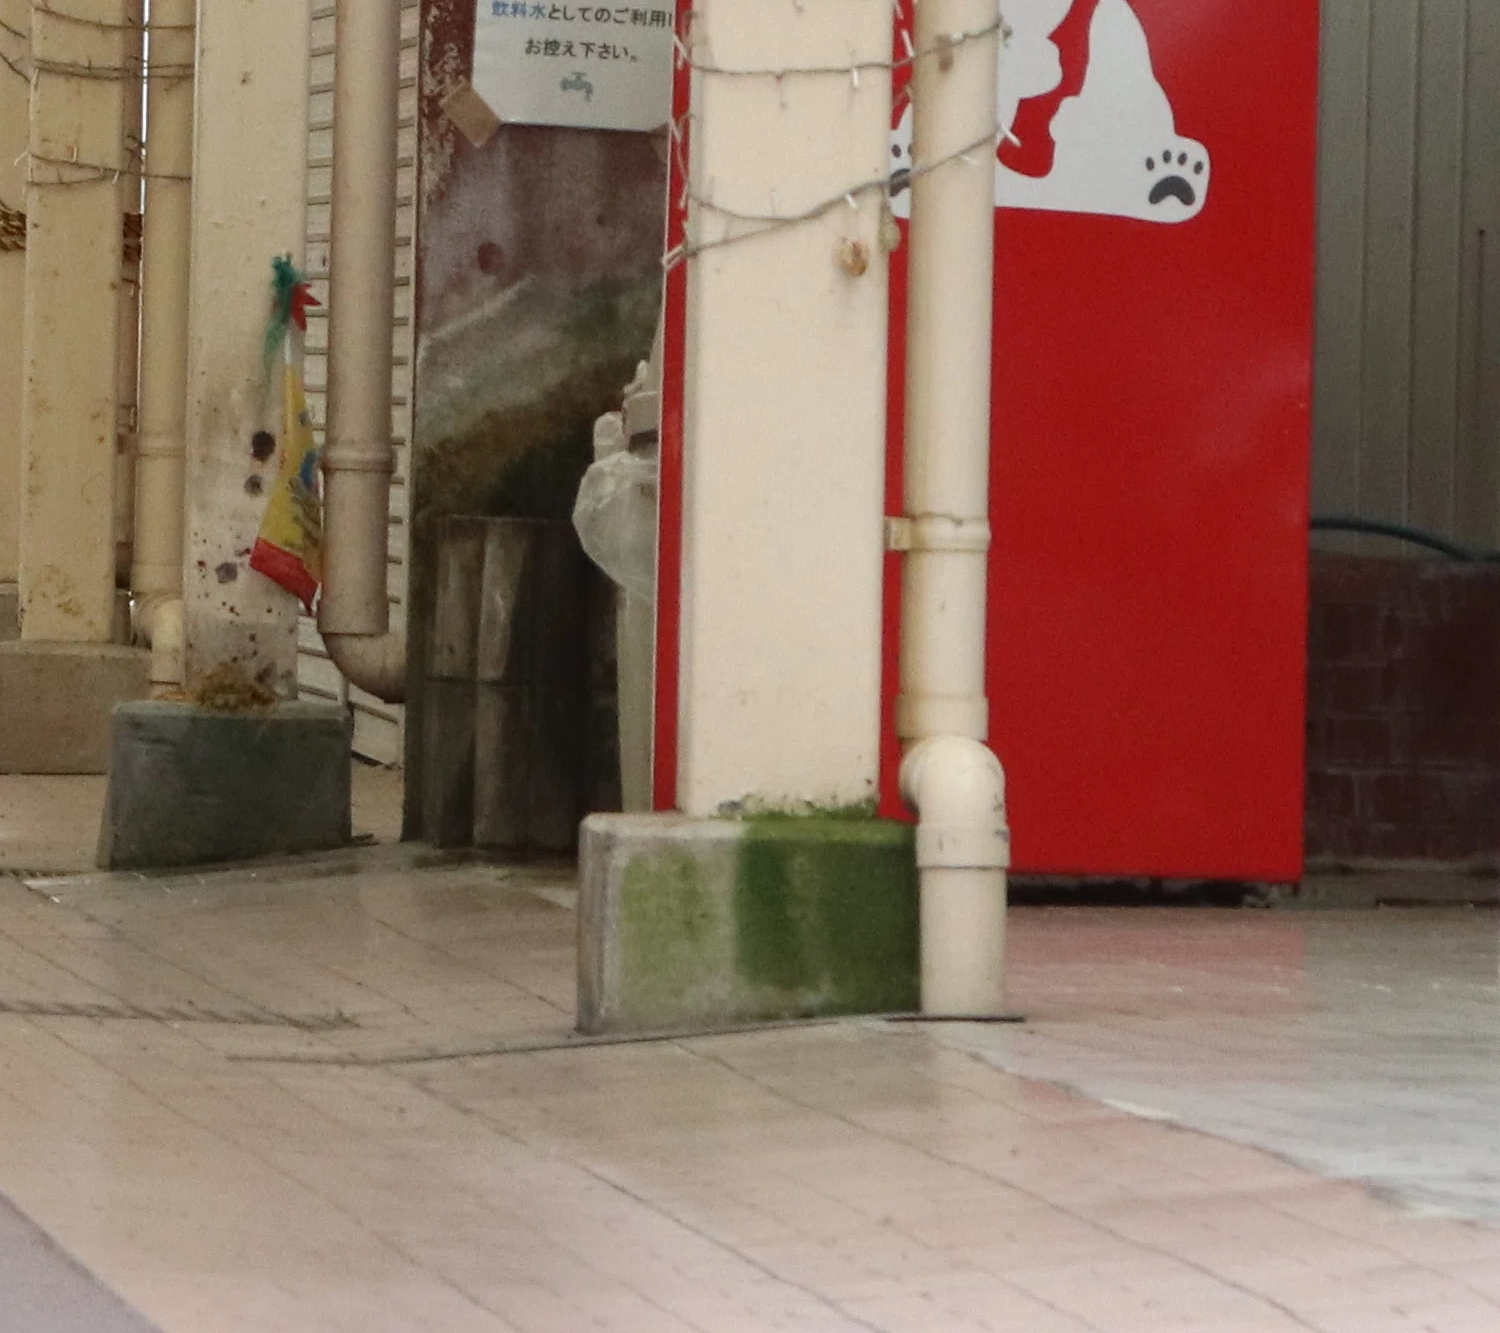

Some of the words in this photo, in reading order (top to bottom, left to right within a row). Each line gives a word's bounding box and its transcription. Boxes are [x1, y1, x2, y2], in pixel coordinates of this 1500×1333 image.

[491, 0, 673, 28] 飲料水としてのご利用
[525, 37, 638, 63] お控え下さい。
